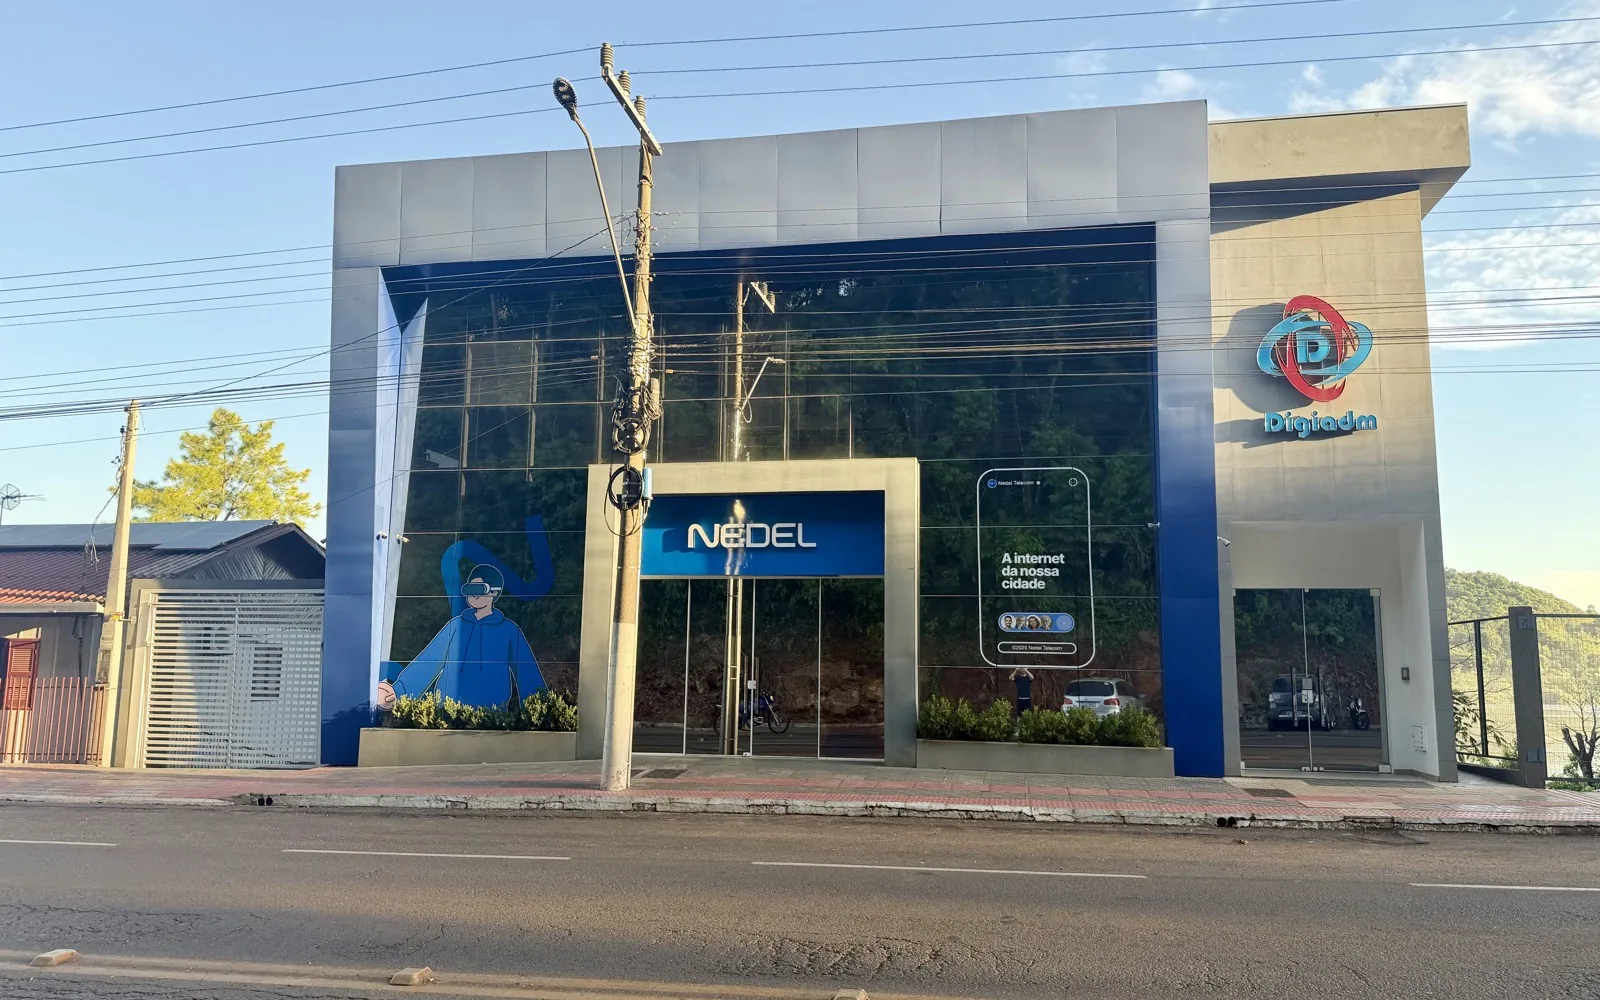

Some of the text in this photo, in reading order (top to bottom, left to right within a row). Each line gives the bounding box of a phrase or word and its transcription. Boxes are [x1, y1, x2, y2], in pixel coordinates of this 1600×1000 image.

[1264, 410, 1378, 438] Digiadm
[687, 522, 817, 549] NEDEL
[1002, 552, 1065, 564] A internet
[1002, 565, 1060, 576] da nossa
[1001, 577, 1046, 589] cidade
